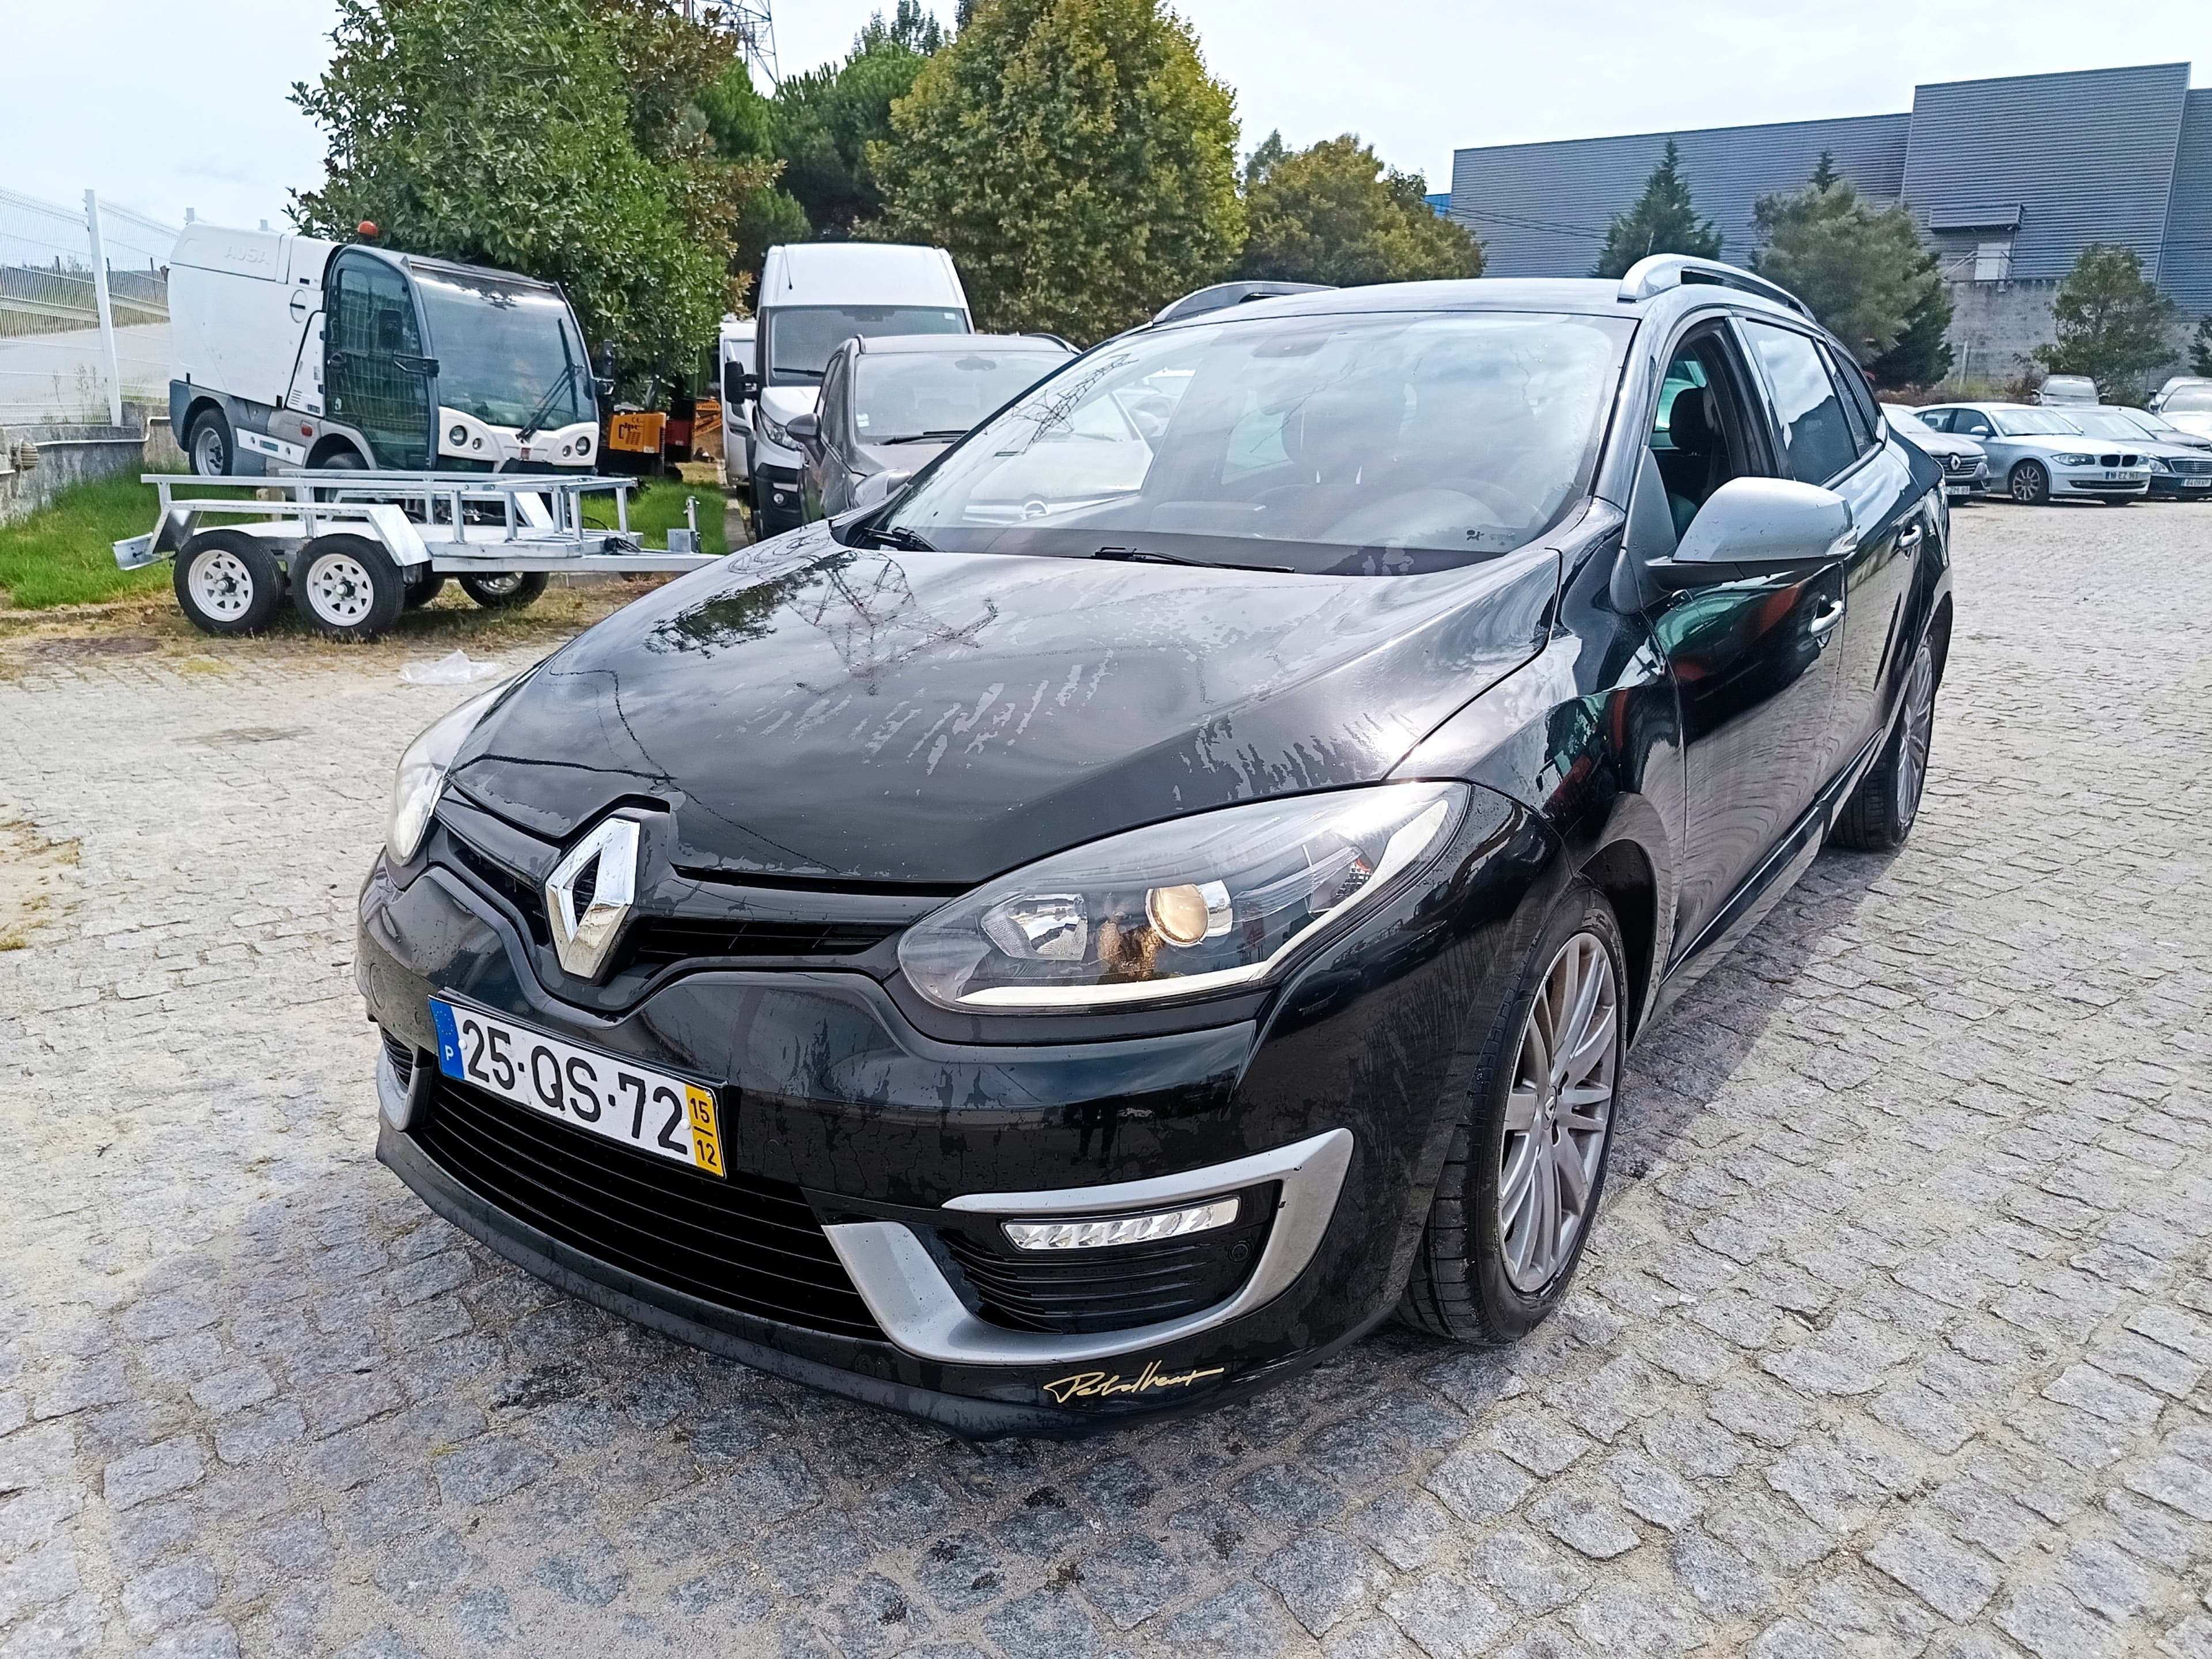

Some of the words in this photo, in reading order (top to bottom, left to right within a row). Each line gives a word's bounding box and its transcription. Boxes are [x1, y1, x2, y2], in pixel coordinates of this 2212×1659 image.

[445, 1044, 454, 1061] P
[690, 1097, 710, 1123] 15
[697, 1139, 717, 1166] 12
